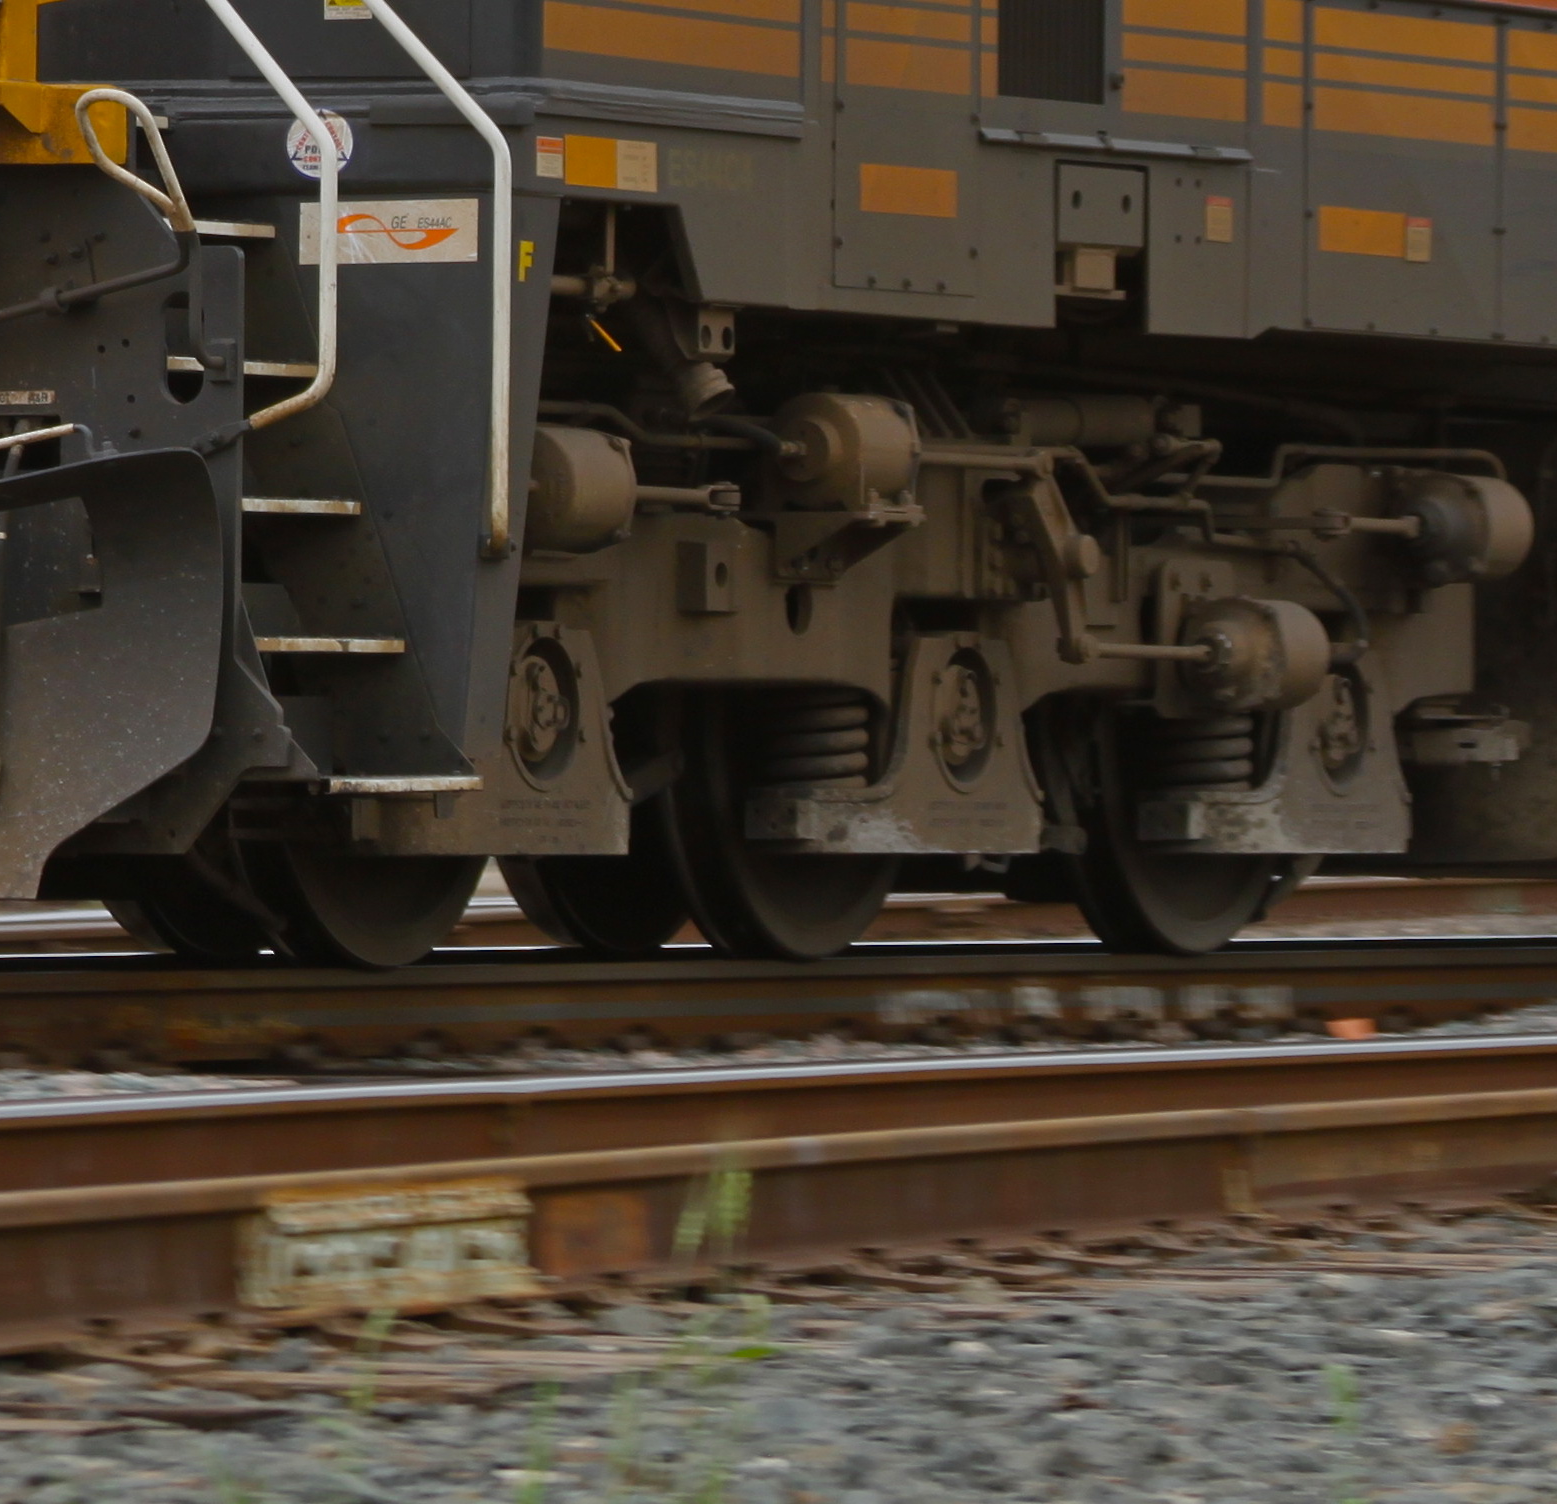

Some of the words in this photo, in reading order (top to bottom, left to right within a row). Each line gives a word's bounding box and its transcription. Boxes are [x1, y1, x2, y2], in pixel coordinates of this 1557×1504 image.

[390, 215, 408, 229] GE
[417, 216, 453, 229] ES44AC
[518, 239, 535, 282] F
